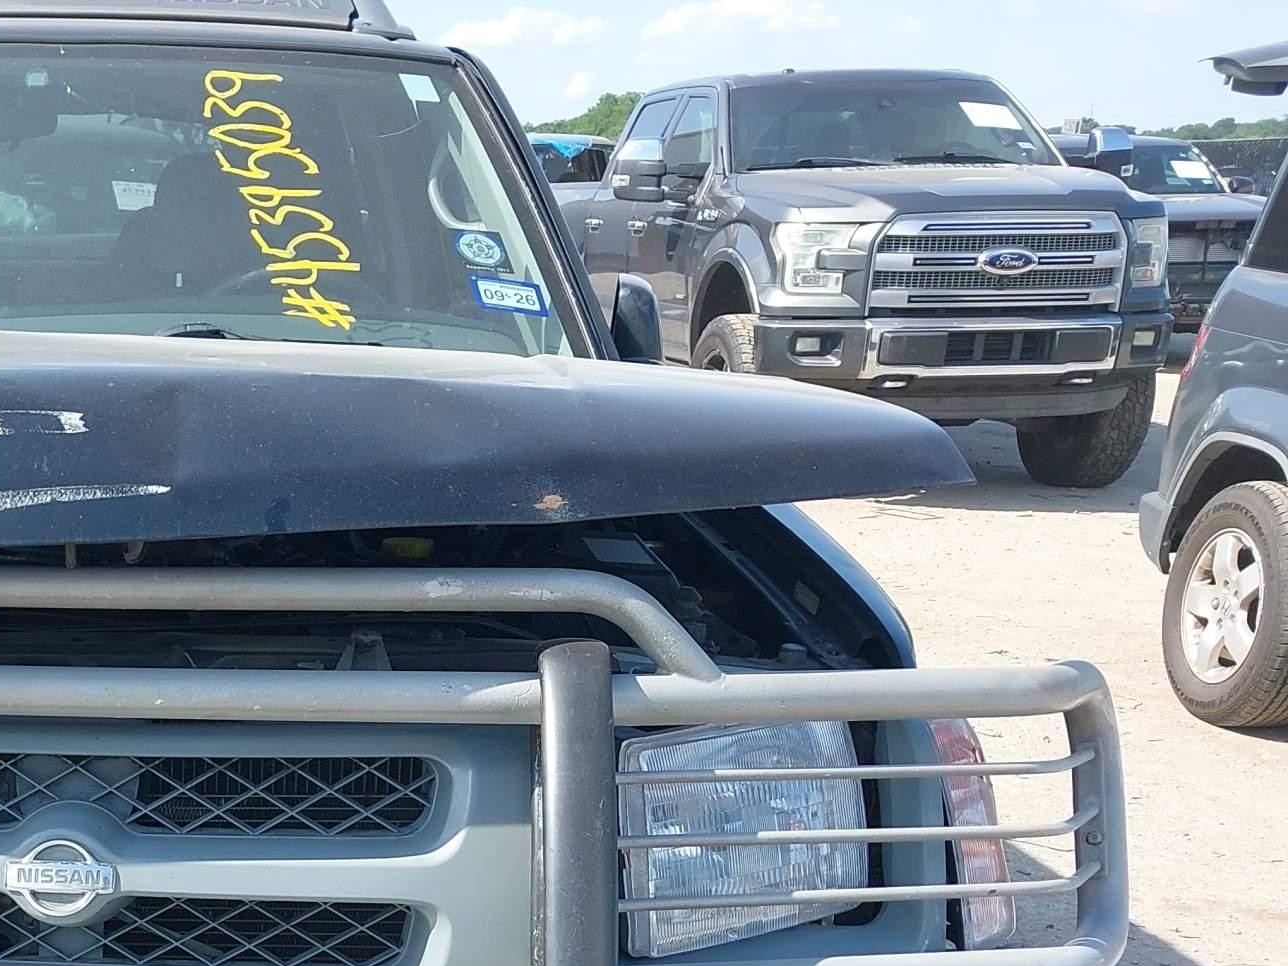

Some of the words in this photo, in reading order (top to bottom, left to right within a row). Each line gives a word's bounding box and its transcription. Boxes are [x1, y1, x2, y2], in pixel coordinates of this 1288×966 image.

[203, 70, 360, 330] #45395039
[996, 254, 1026, 268] Ford
[17, 868, 101, 885] NISSAN
